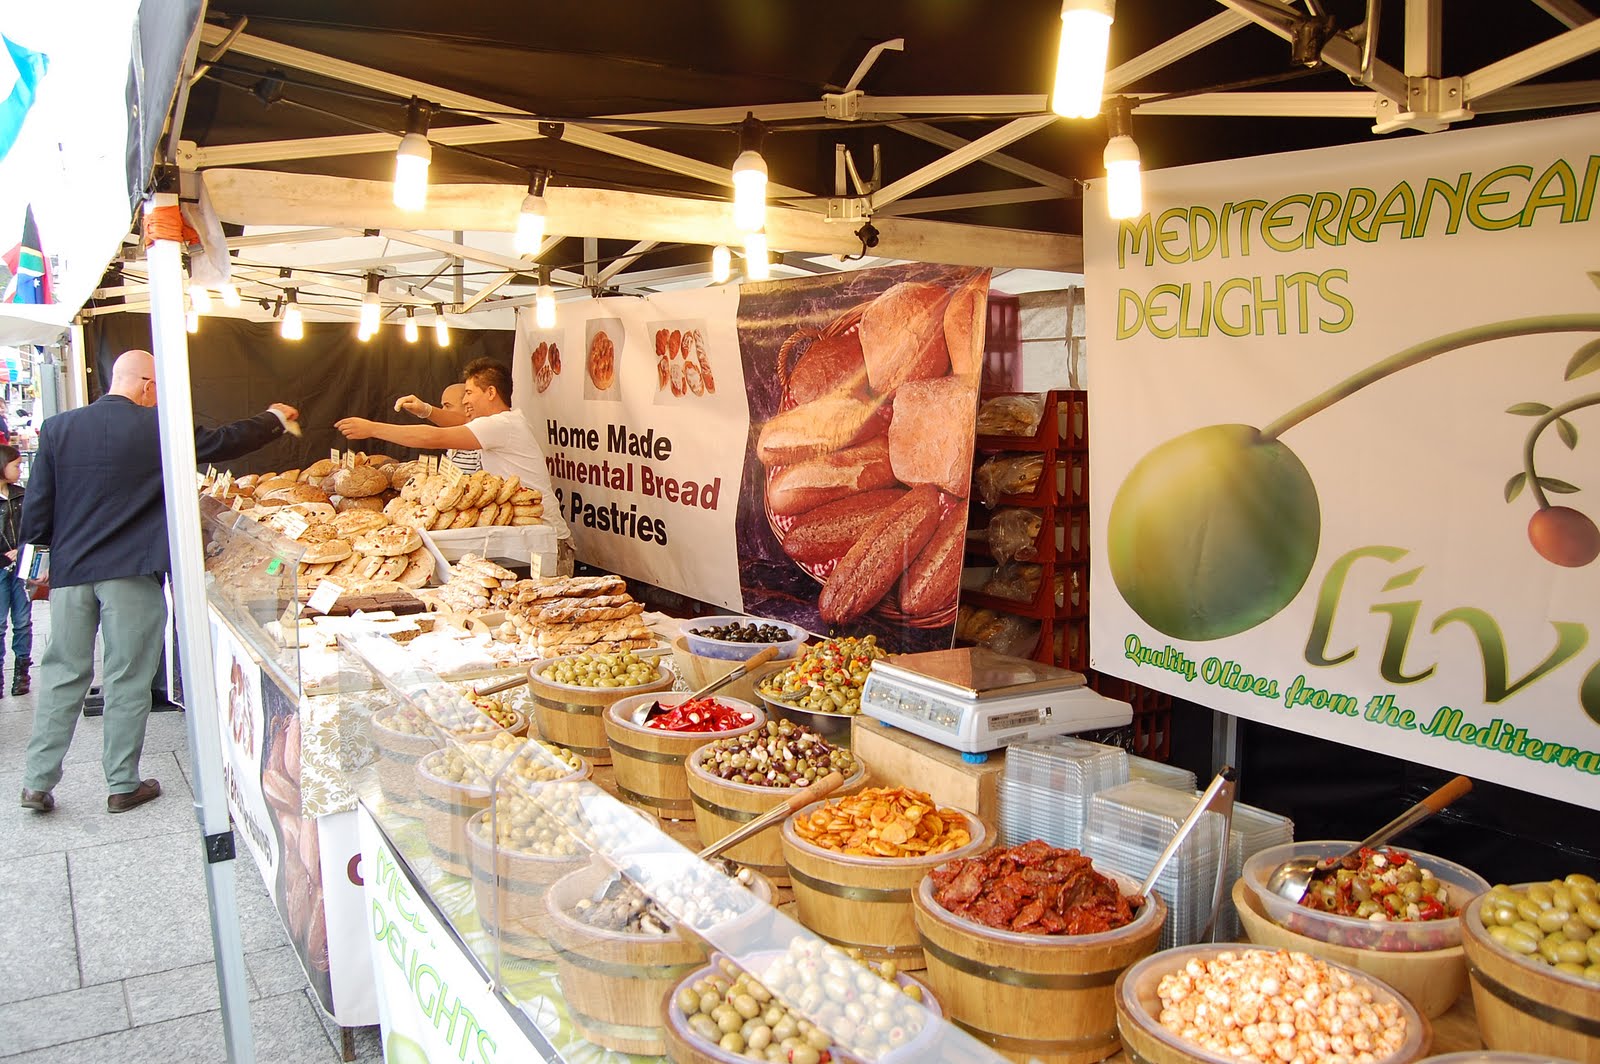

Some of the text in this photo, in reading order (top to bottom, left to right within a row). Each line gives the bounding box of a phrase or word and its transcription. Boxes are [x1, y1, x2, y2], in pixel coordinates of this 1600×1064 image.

[1115, 268, 1355, 341] DELIGHTS
[546, 419, 672, 461] Home Made
[546, 452, 721, 510] ntinental Bread
[570, 491, 668, 546] Pastries
[1124, 633, 1198, 682] Quality
[1200, 656, 1280, 699] Olives
[1284, 674, 1359, 717] from
[1364, 693, 1417, 731] the
